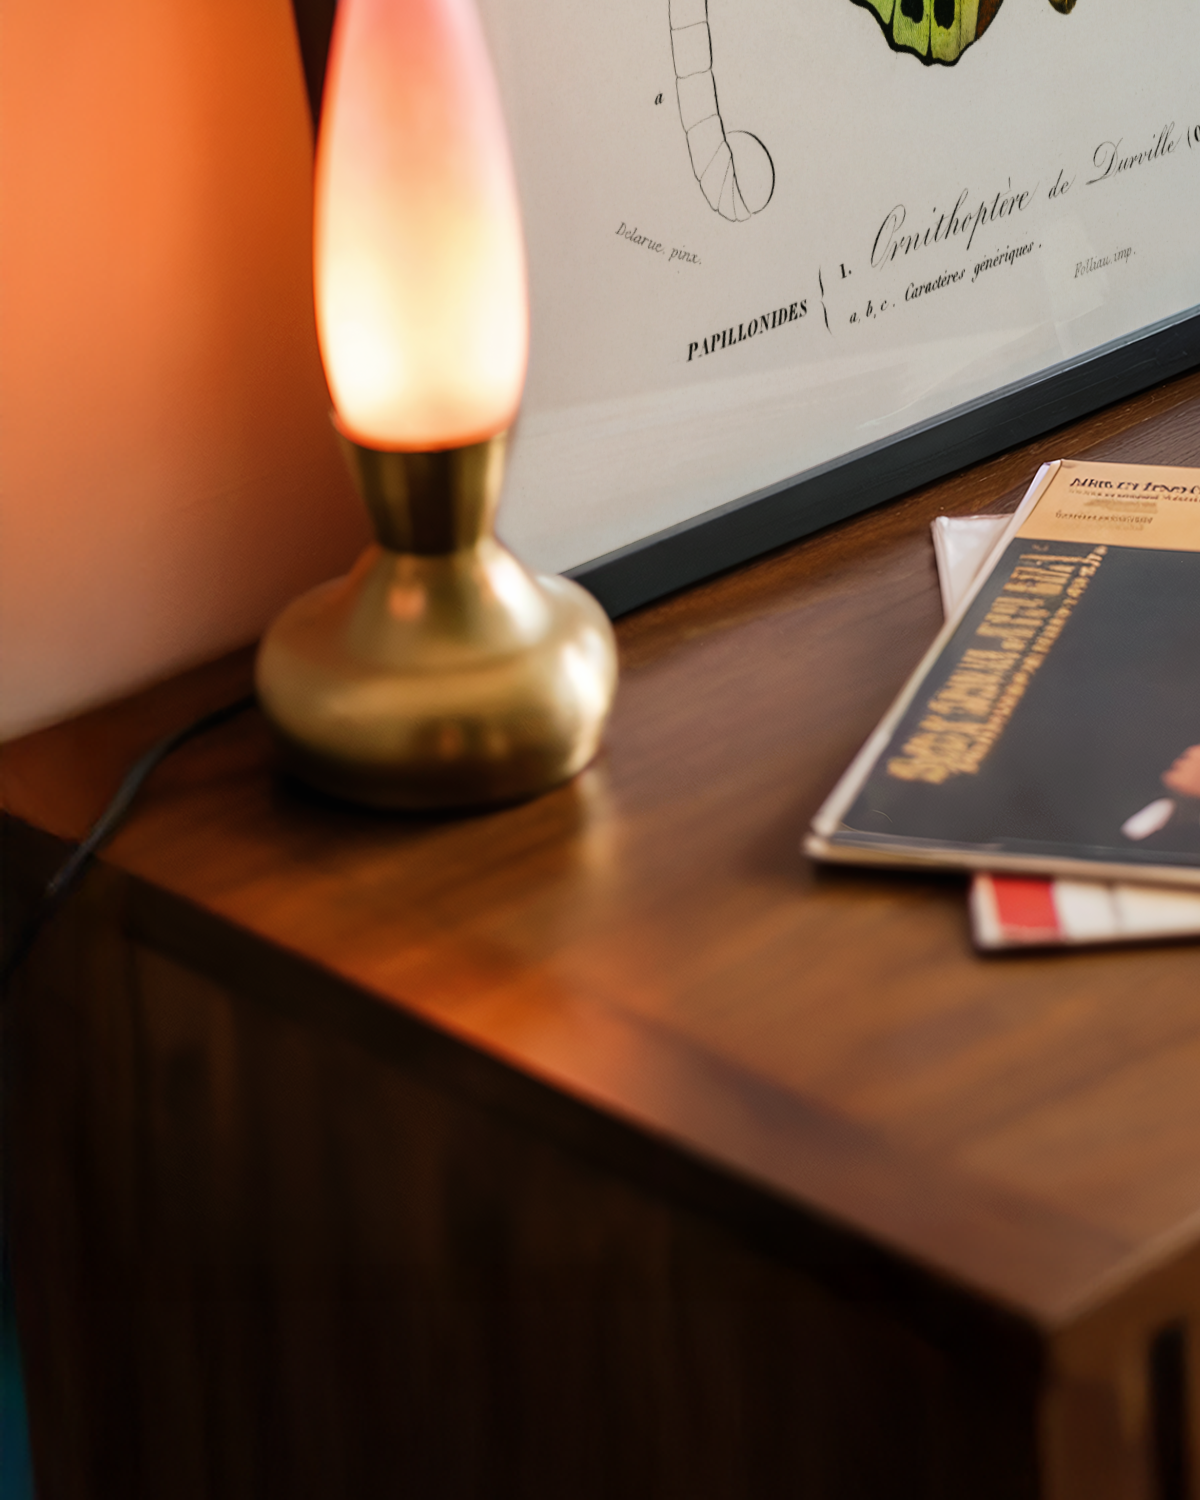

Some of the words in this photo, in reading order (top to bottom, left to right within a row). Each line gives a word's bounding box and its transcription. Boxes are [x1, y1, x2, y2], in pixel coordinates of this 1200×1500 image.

[654, 92, 664, 106] a
[1048, 168, 1076, 200] de
[1085, 121, 1182, 186] Durville
[686, 299, 808, 362] PAPILLONIDES
